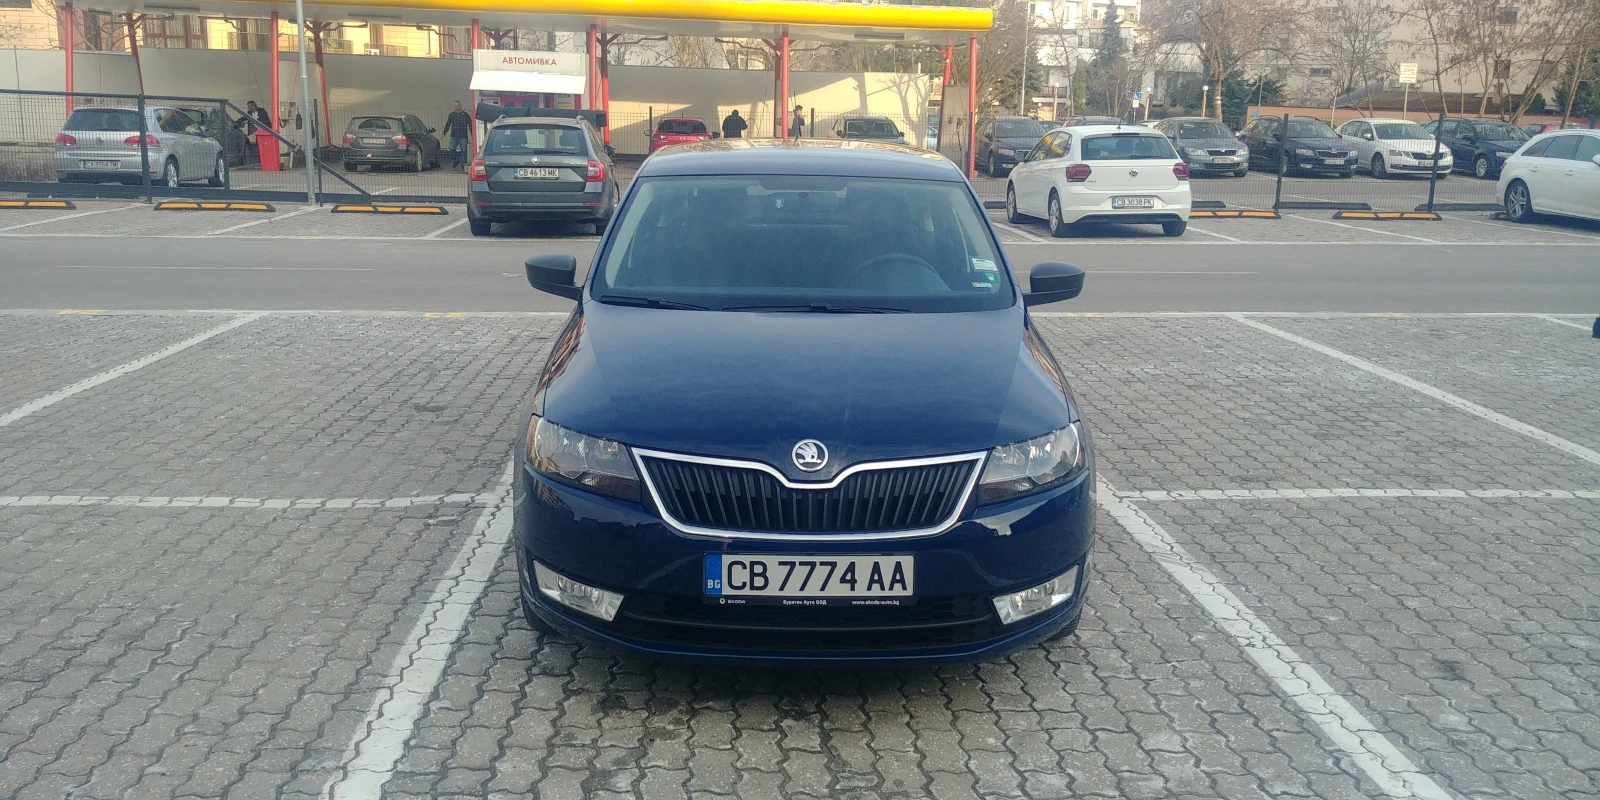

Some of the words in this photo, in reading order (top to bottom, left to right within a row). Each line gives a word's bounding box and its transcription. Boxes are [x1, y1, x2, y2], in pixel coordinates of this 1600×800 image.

[502, 56, 557, 66] АВТОМИВКА
[518, 168, 529, 177] CB
[529, 168, 547, 177] 4613
[547, 168, 558, 177] MK
[1116, 198, 1126, 206] CB
[1126, 198, 1143, 206] 3038
[1143, 198, 1152, 206] PK
[707, 579, 721, 589] BG
[727, 560, 770, 591] CB
[778, 561, 858, 592] 7774
[866, 561, 908, 592] AA
